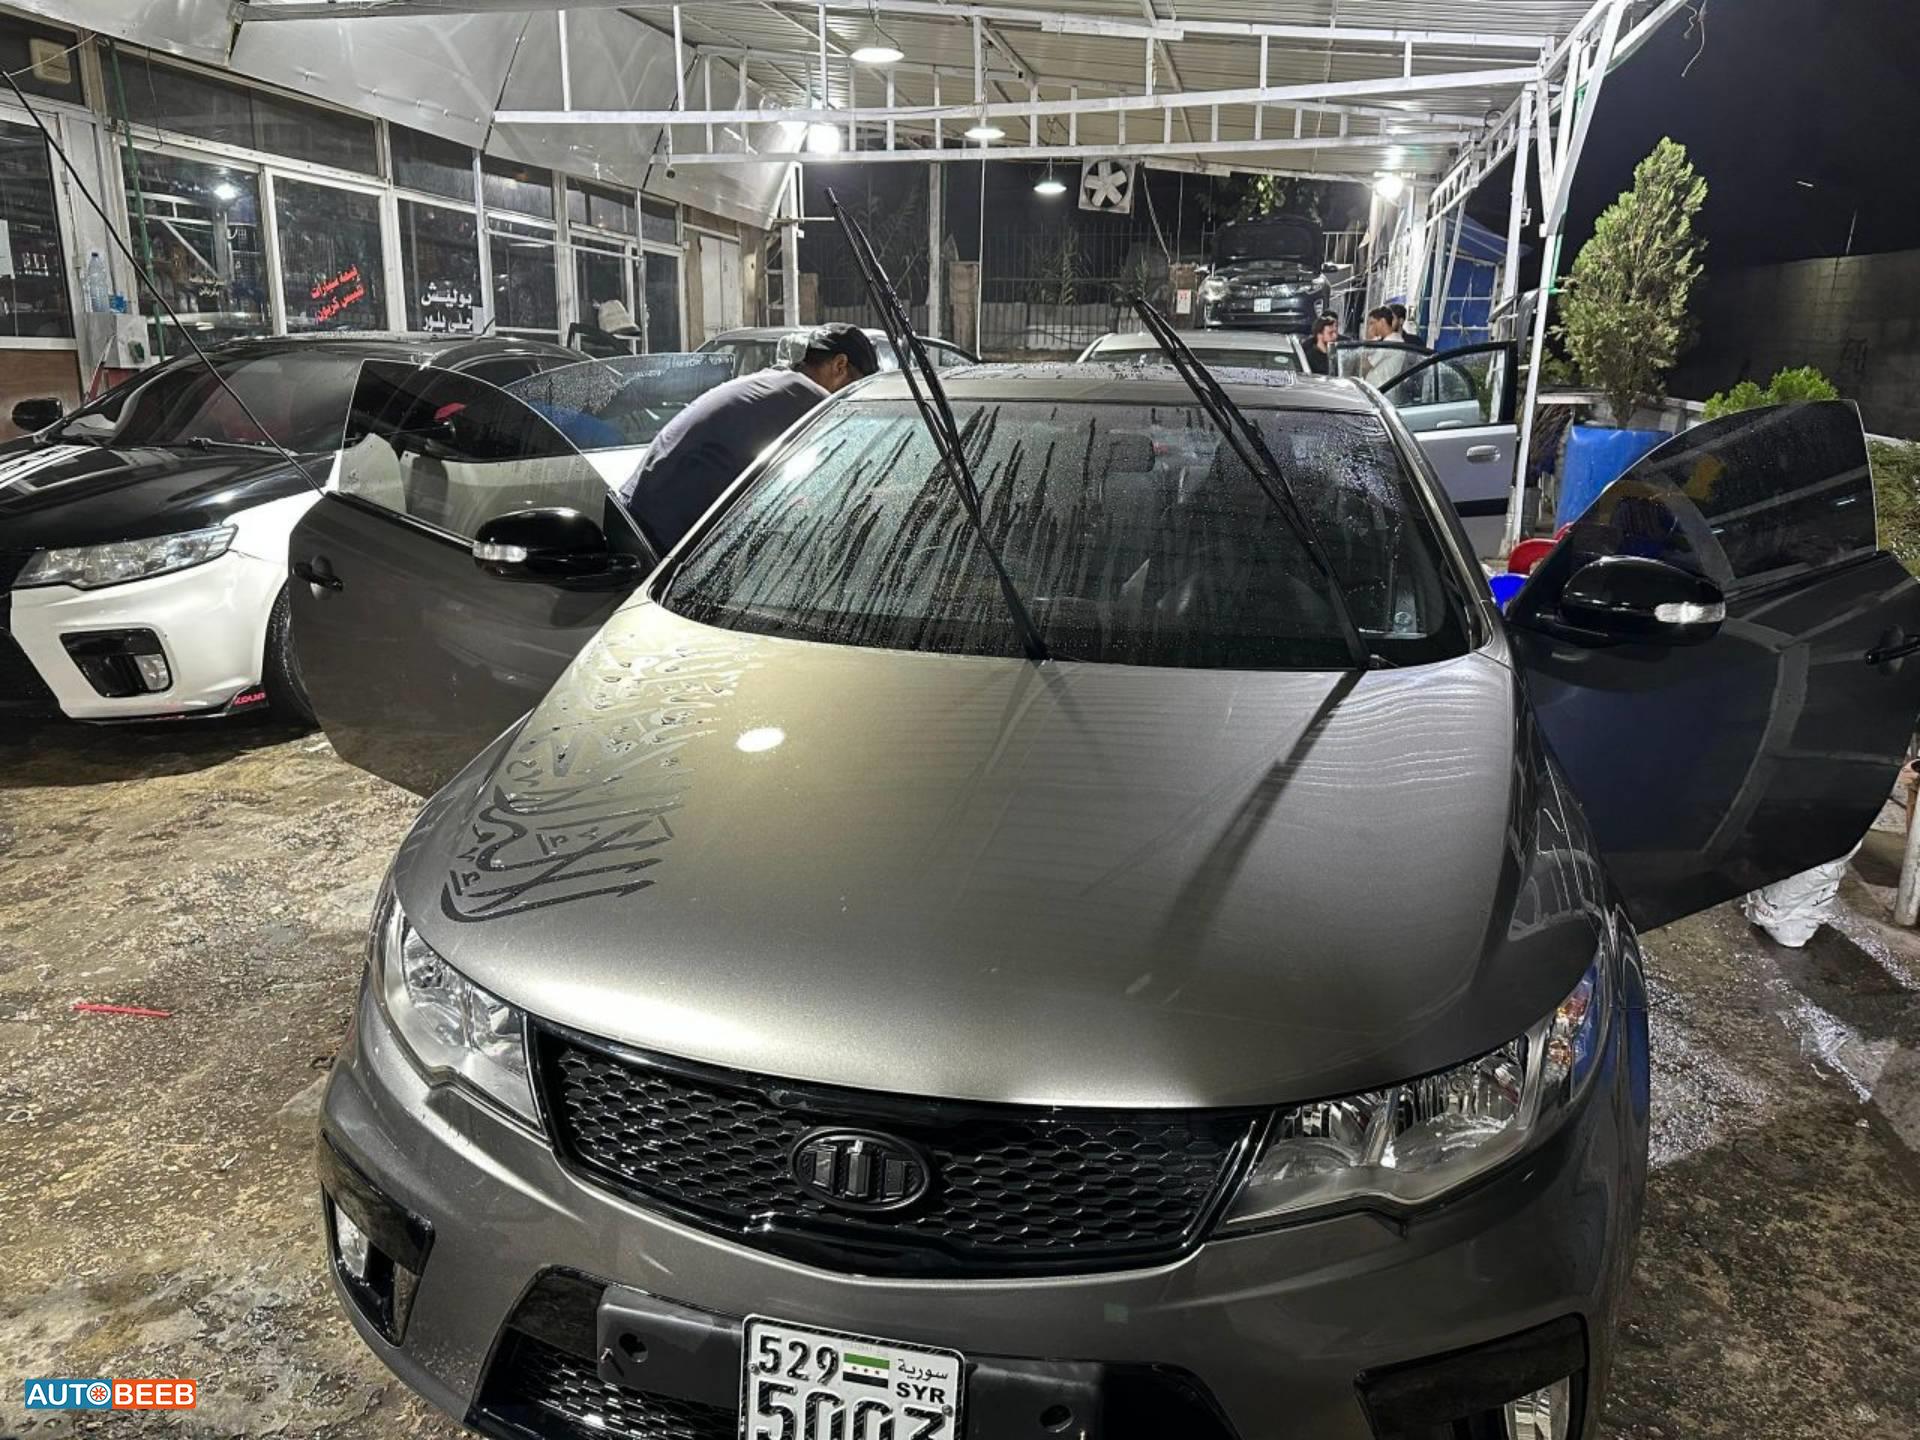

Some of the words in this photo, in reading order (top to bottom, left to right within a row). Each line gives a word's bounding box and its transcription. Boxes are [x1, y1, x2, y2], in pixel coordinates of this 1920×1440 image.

[759, 1335, 839, 1385] 529
[898, 1358, 948, 1381] سورية
[896, 1382, 945, 1404] SYR
